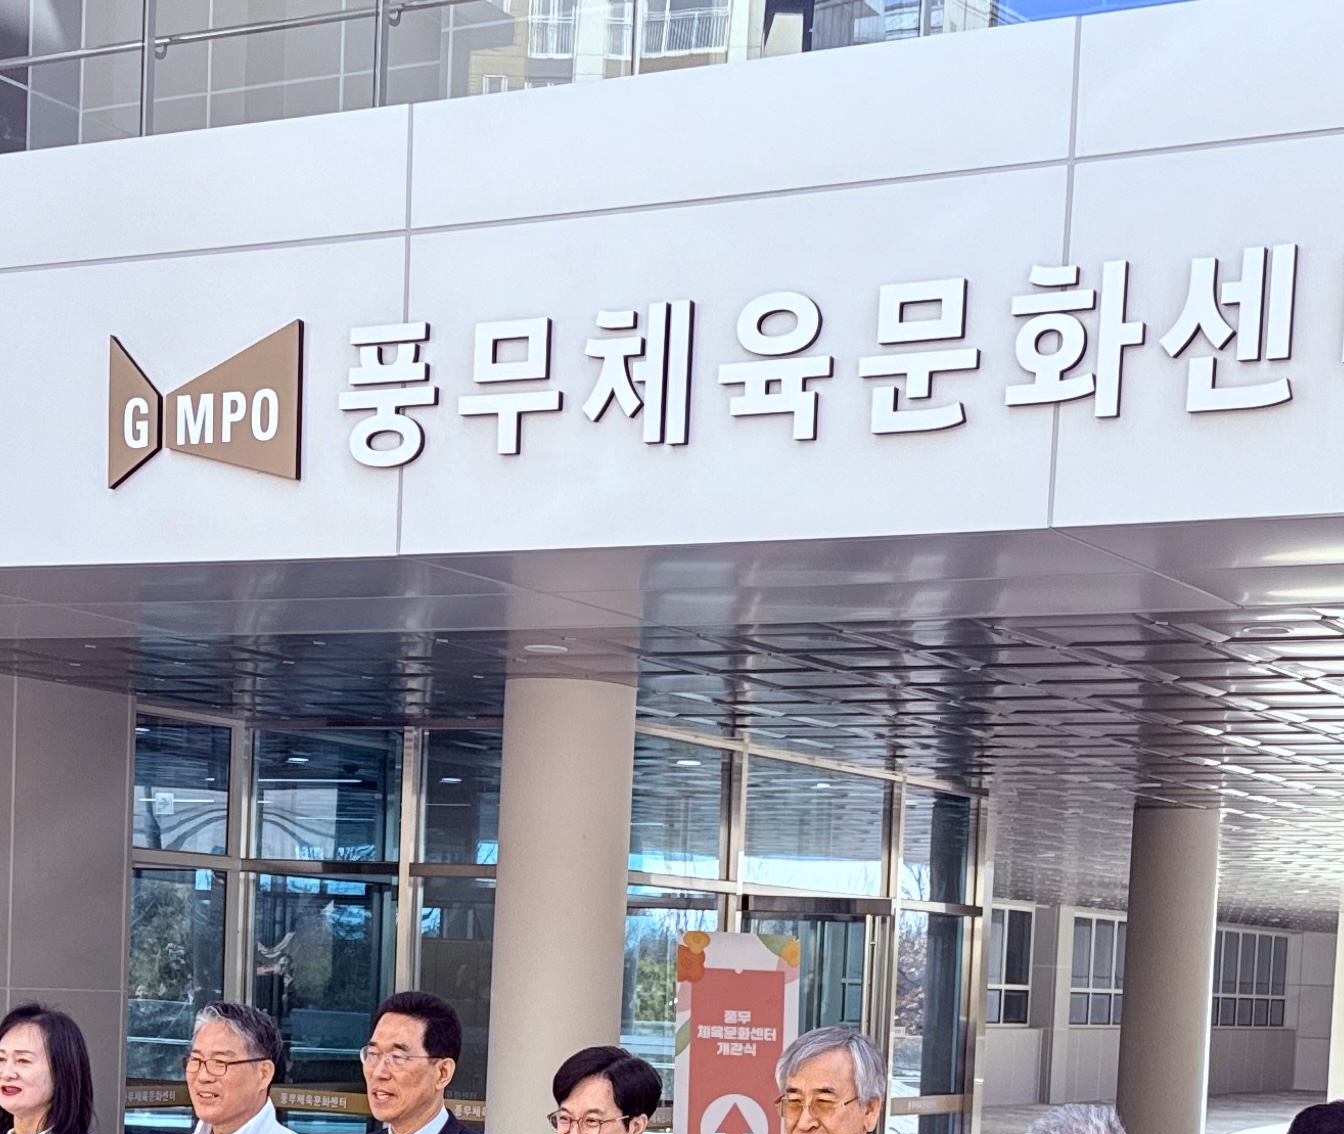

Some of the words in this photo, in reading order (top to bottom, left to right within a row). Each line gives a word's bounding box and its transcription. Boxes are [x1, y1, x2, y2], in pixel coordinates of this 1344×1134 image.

[724, 1010, 751, 1024] 풍무
[697, 1025, 776, 1041] 체육문화센터
[717, 1042, 757, 1056] 개관식
[127, 1090, 176, 1102] 무체육문화센터
[280, 1092, 347, 1109] 풍무체육문화센터
